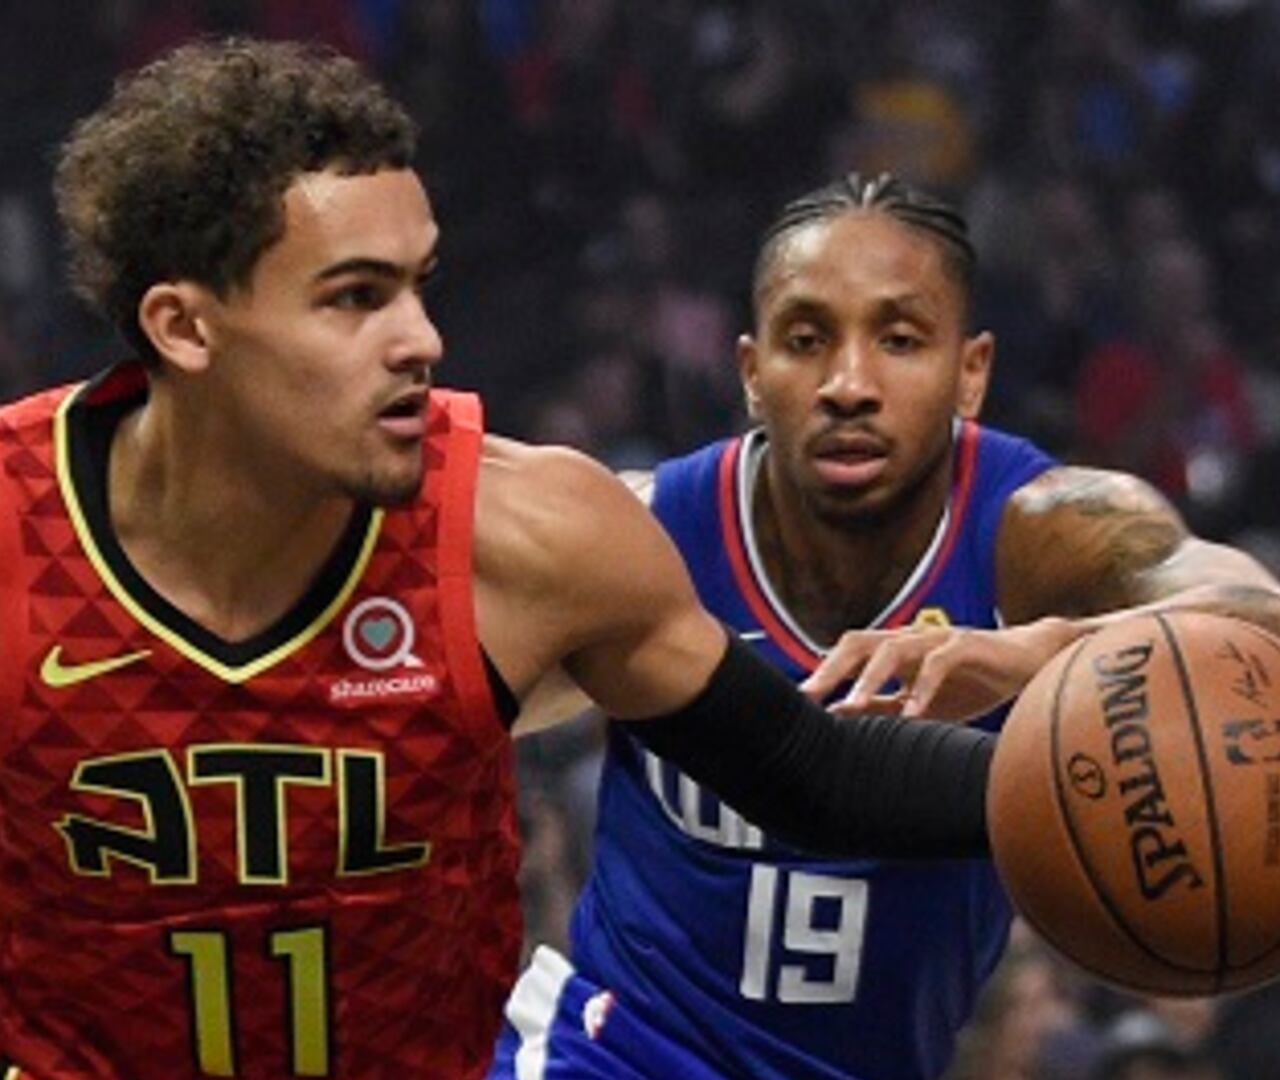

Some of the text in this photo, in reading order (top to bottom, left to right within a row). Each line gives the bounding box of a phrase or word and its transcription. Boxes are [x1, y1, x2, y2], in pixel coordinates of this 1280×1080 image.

[330, 674, 436, 701] sharecare
[54, 744, 431, 885] ATL
[1093, 640, 1203, 901] SPALDING
[169, 926, 331, 1078] 11
[739, 863, 869, 1004] 19
